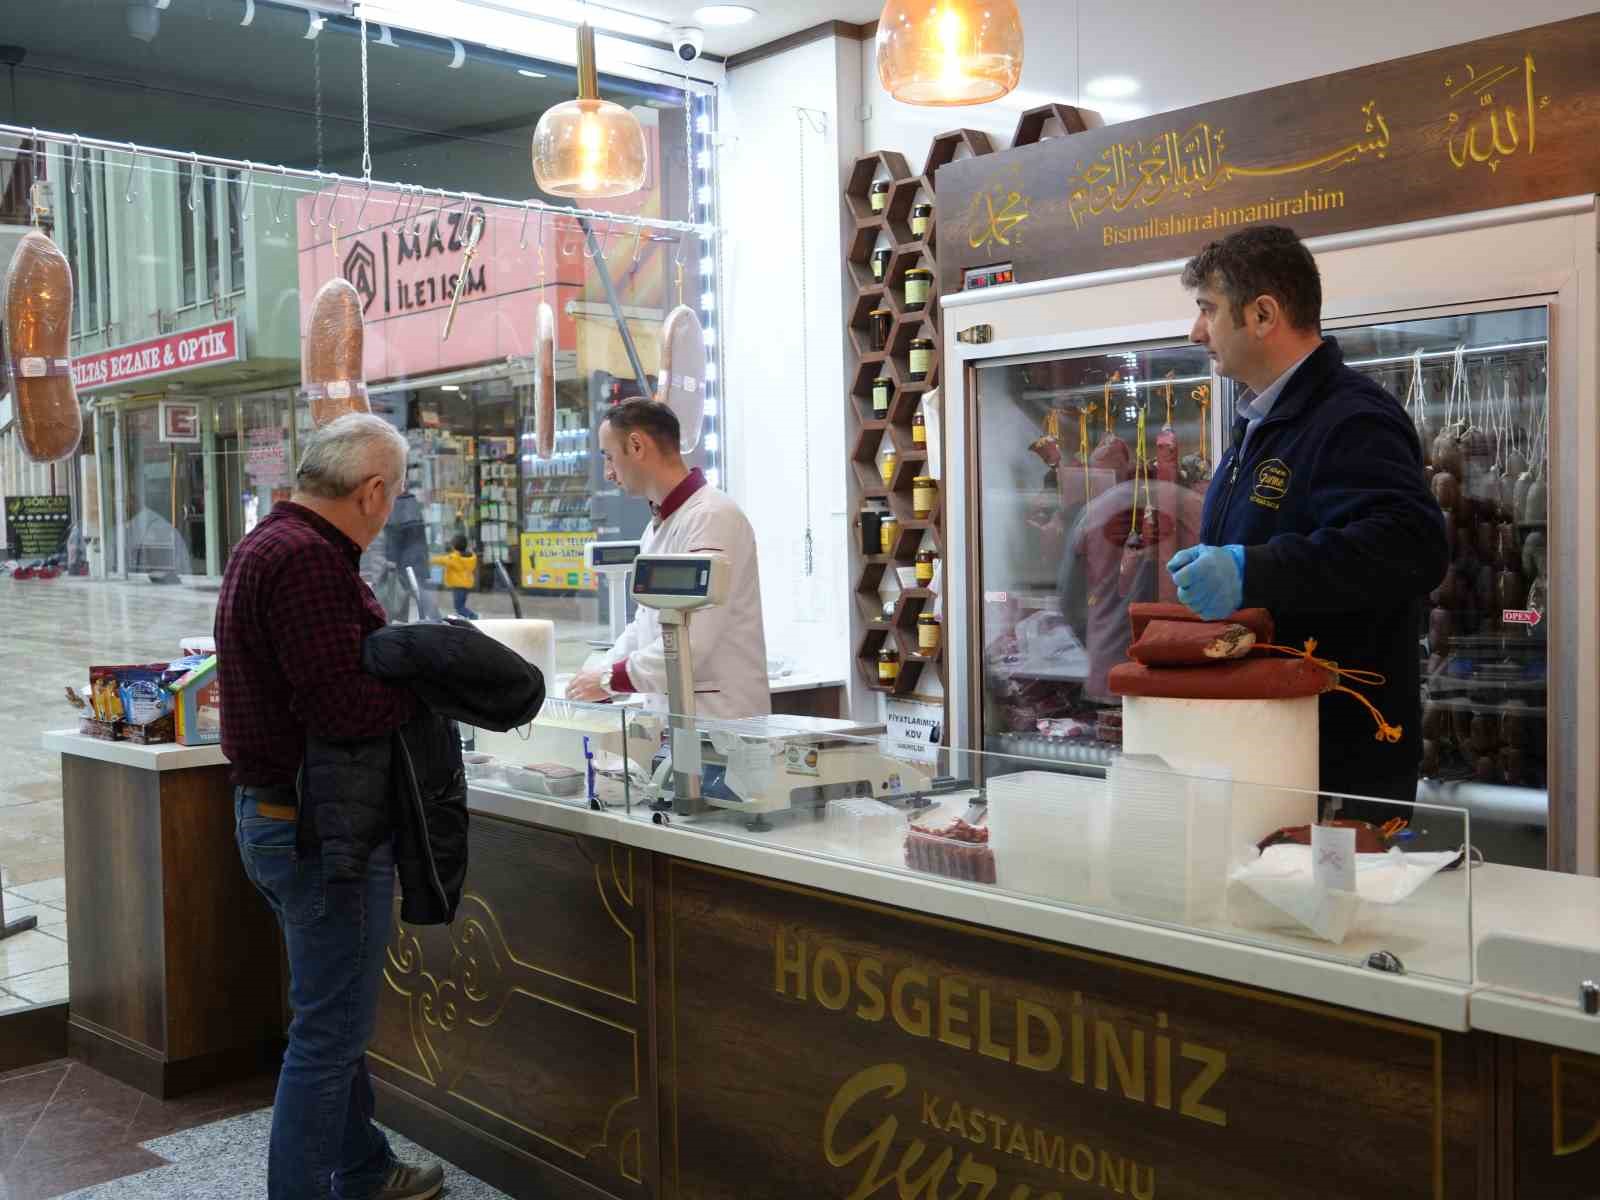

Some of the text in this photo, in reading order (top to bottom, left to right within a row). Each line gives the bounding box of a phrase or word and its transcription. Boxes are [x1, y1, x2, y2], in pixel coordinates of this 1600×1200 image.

[1103, 188, 1345, 247] Bismillahirrahmanirrahim
[111, 348, 160, 378] ECZANE
[163, 344, 175, 366] &
[178, 329, 227, 362] OPTİK
[1505, 611, 1530, 620] OPEN
[920, 1089, 1156, 1200] KASTAMONU
